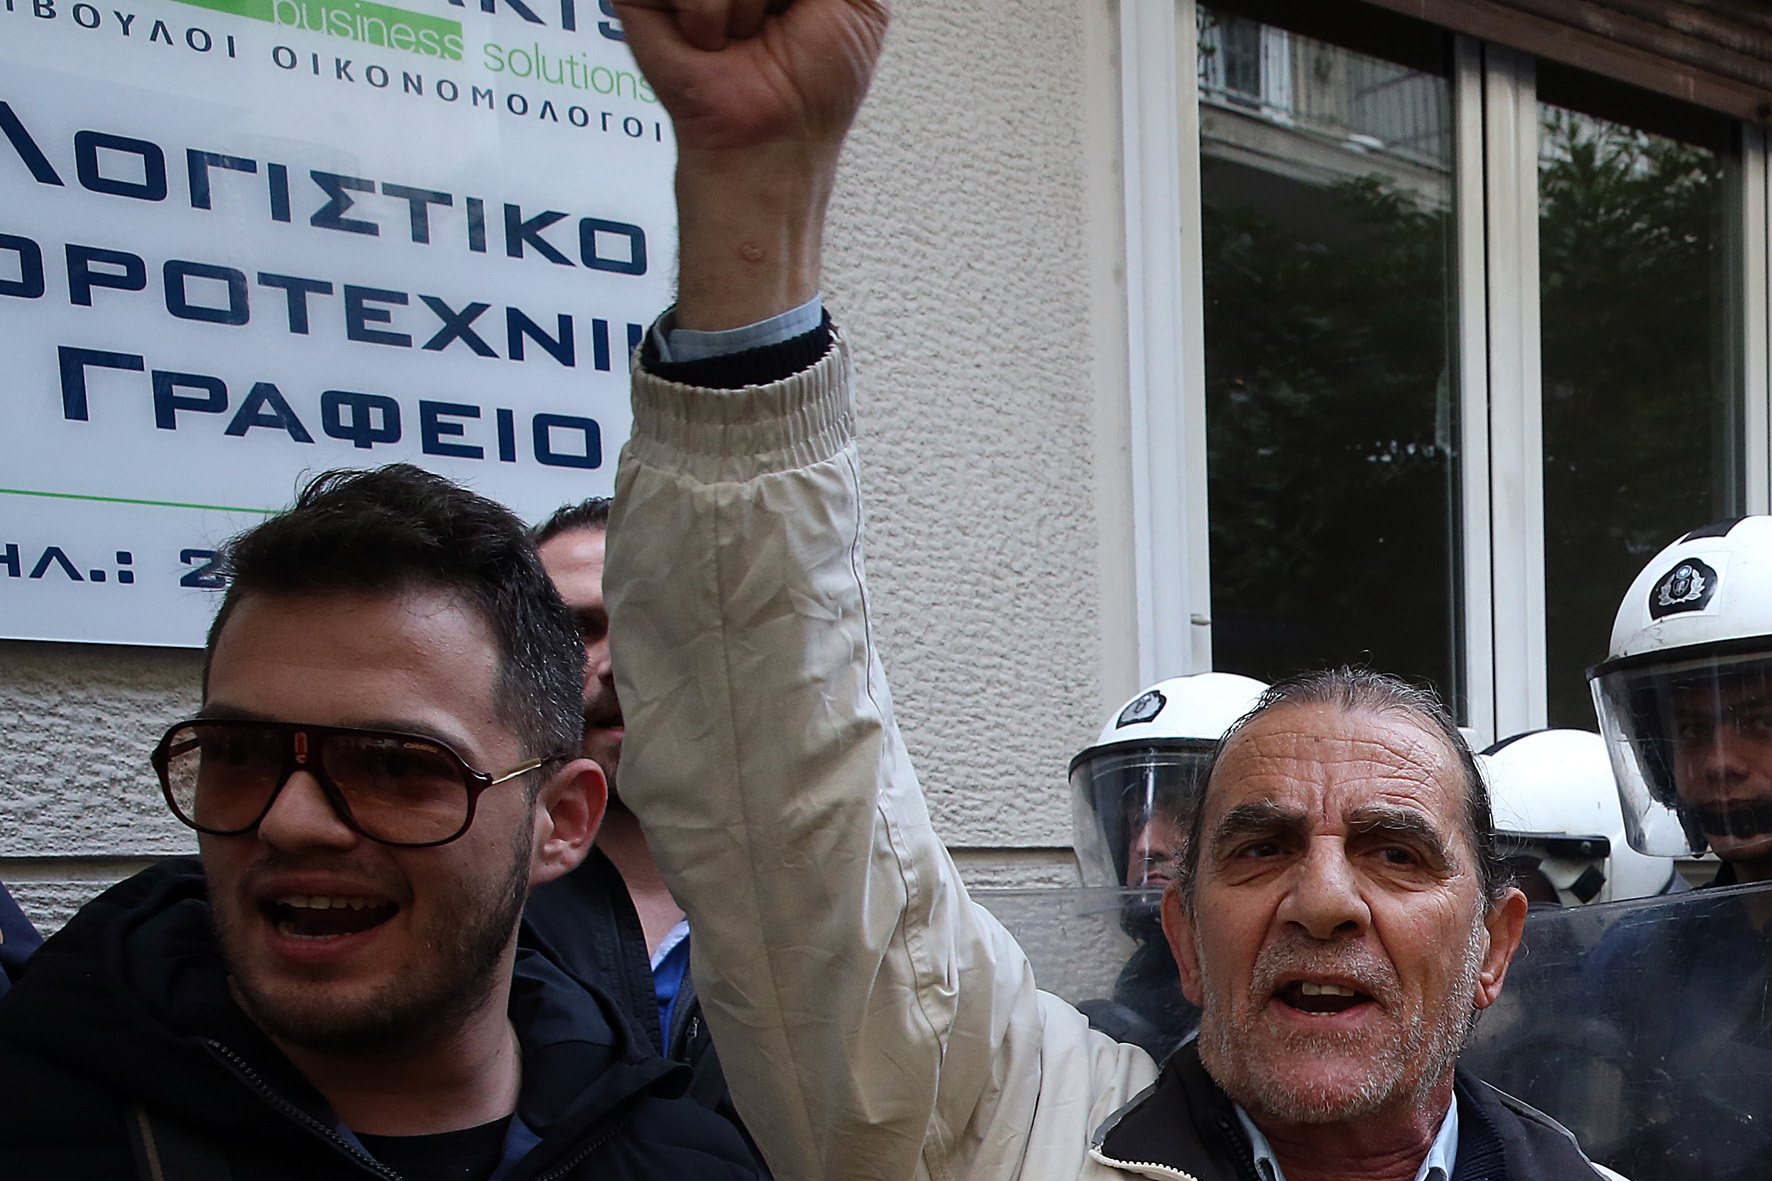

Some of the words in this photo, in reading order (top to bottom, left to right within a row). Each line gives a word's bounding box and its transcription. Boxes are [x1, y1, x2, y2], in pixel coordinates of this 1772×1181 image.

[4, 0, 236, 58] ΒΟΥΛΟΙ
[272, 45, 662, 142] ΟΙΚΟΝΟΜΟΛΟΓΟΙ
[272, 0, 464, 62] business
[483, 42, 658, 104] solutions
[0, 233, 643, 374] ΡΟΤΕΧΝΙ
[57, 345, 603, 469] ΓΡΑΦΕΙΟ
